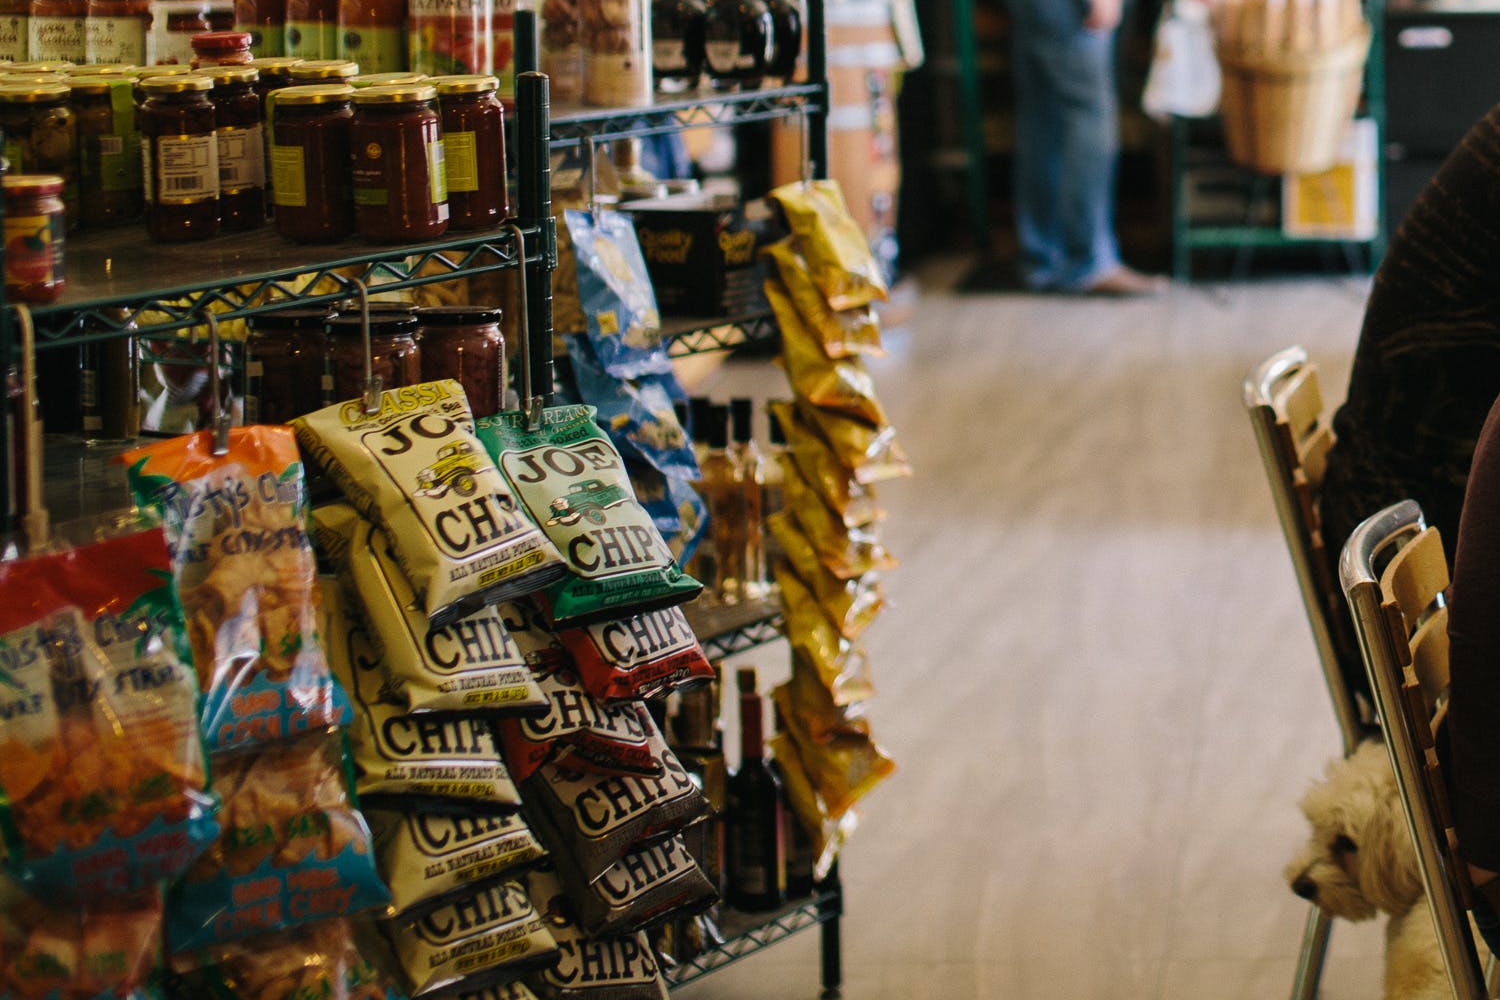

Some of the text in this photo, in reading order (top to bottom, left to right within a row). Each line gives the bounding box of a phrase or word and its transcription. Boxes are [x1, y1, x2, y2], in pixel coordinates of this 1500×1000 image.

[339, 378, 464, 425] CASSIC
[543, 405, 590, 425] REAM
[551, 426, 590, 446] ooked
[518, 445, 619, 484] JOE
